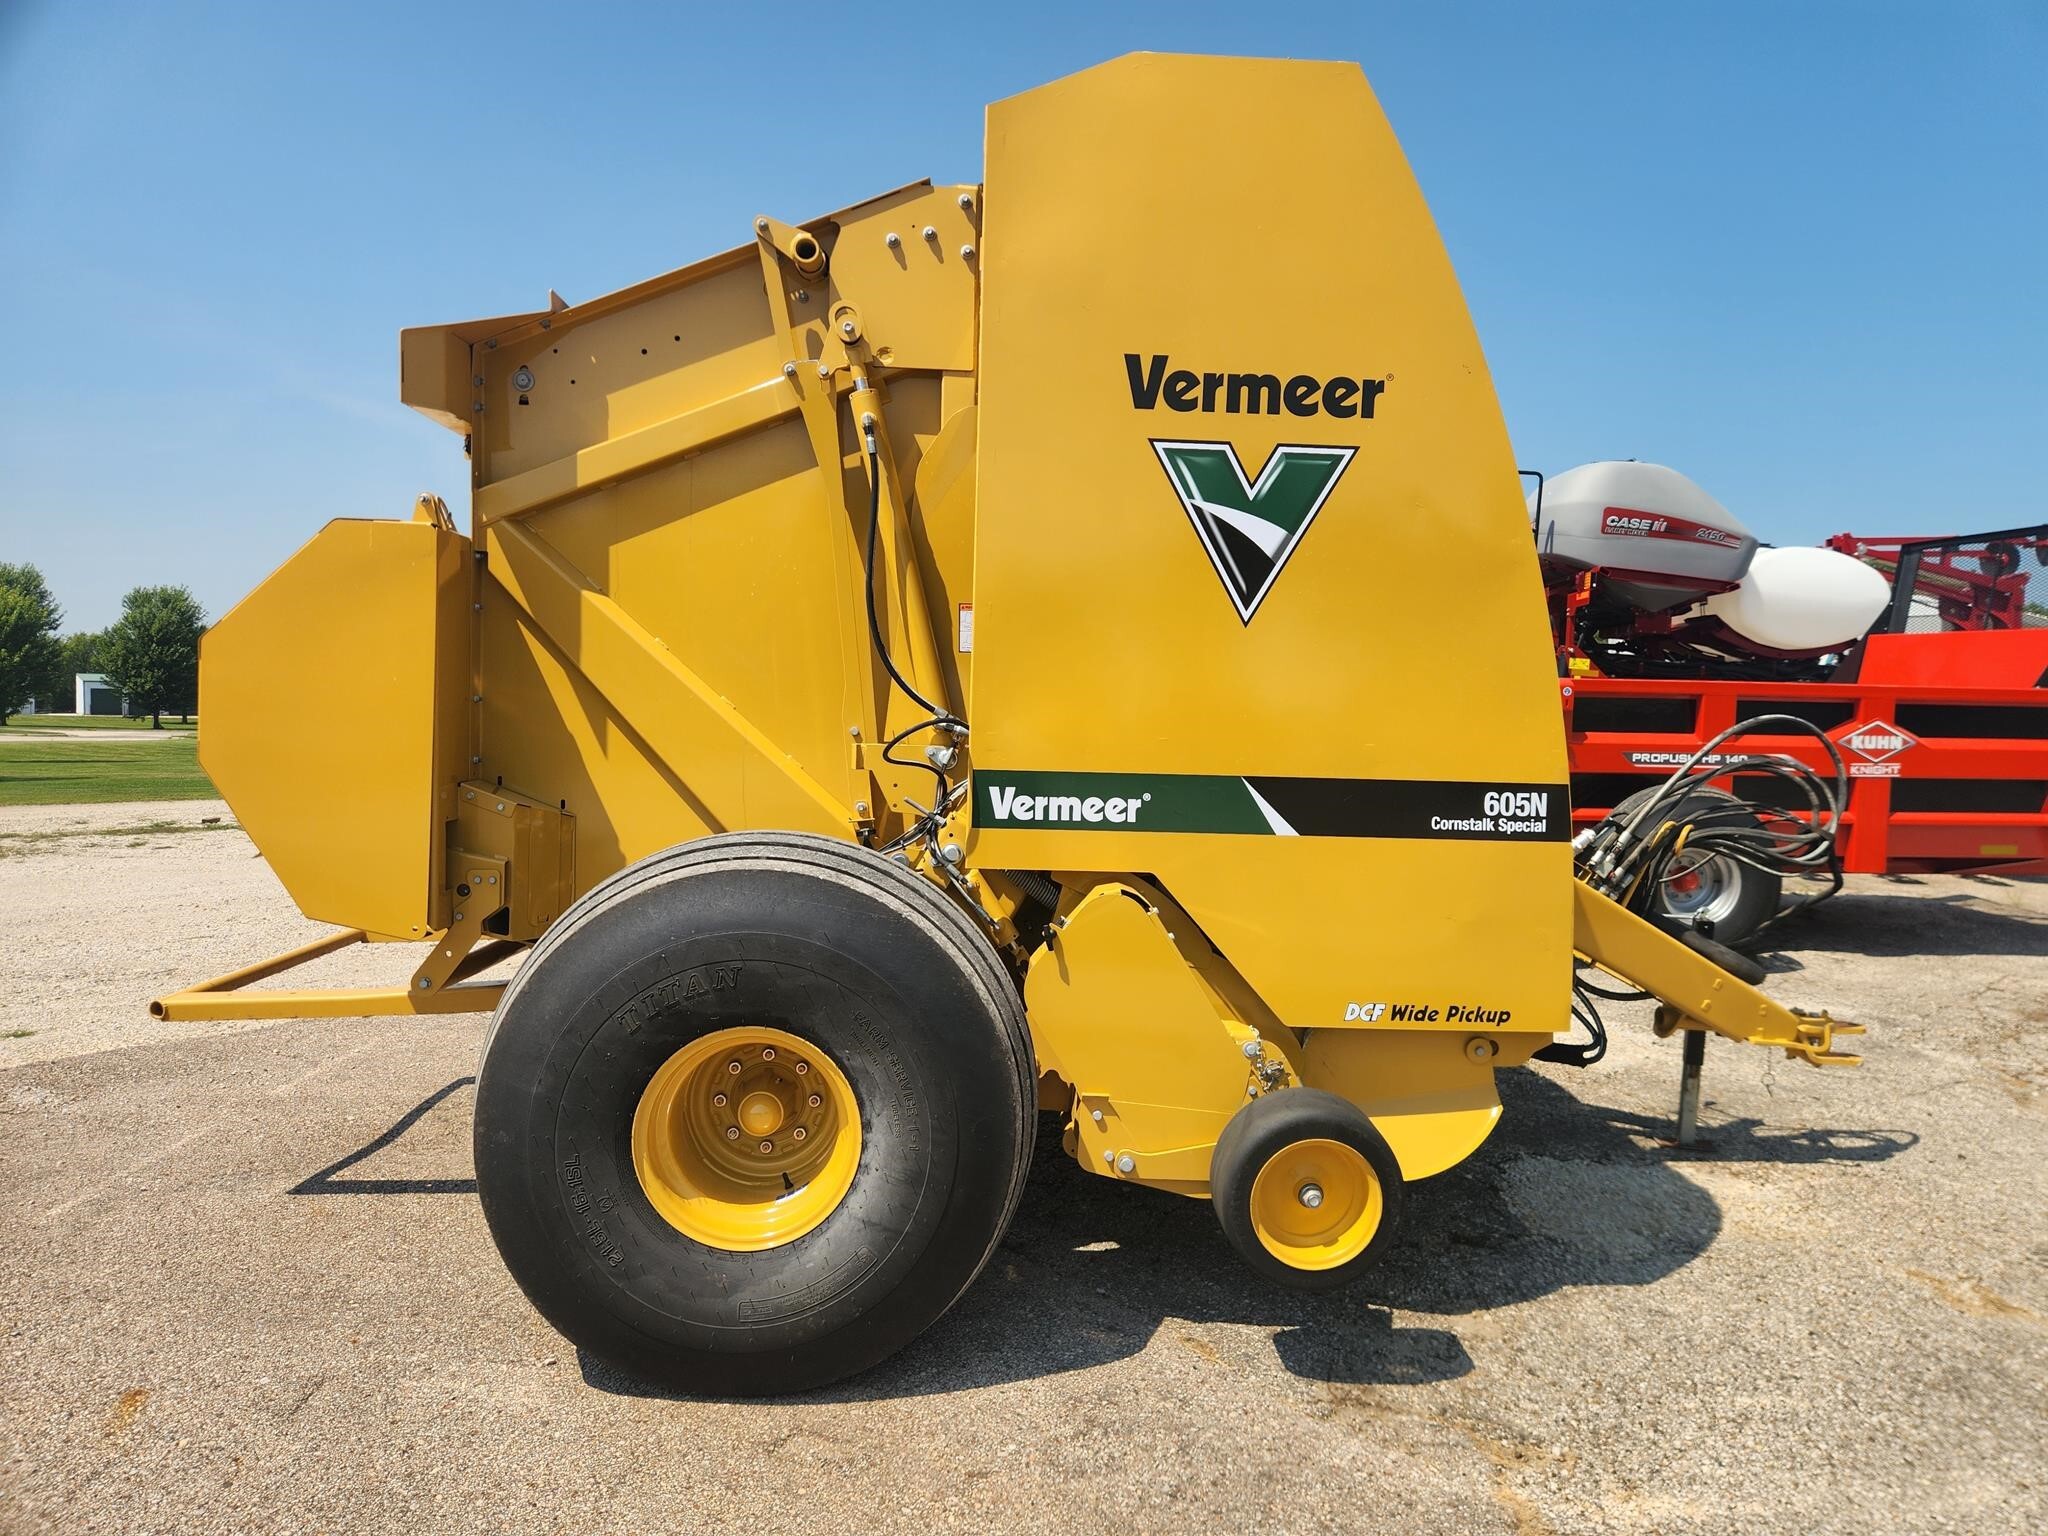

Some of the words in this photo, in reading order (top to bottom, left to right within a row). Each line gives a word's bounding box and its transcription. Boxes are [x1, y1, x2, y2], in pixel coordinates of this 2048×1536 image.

[1606, 515, 1651, 530] CASE
[1696, 528, 1726, 542] 2150
[1851, 735, 1904, 750] KUHN
[1850, 765, 1901, 775] KNIGHT
[1483, 791, 1548, 817] 605N
[1431, 816, 1496, 832] Cornstalk
[1498, 818, 1547, 835] Special
[616, 966, 743, 1034] TITAN
[1344, 1003, 1386, 1022] DCF
[1390, 1004, 1440, 1023] Wide
[1445, 1005, 1511, 1027] Pickup
[885, 1049, 918, 1118] SERVICE
